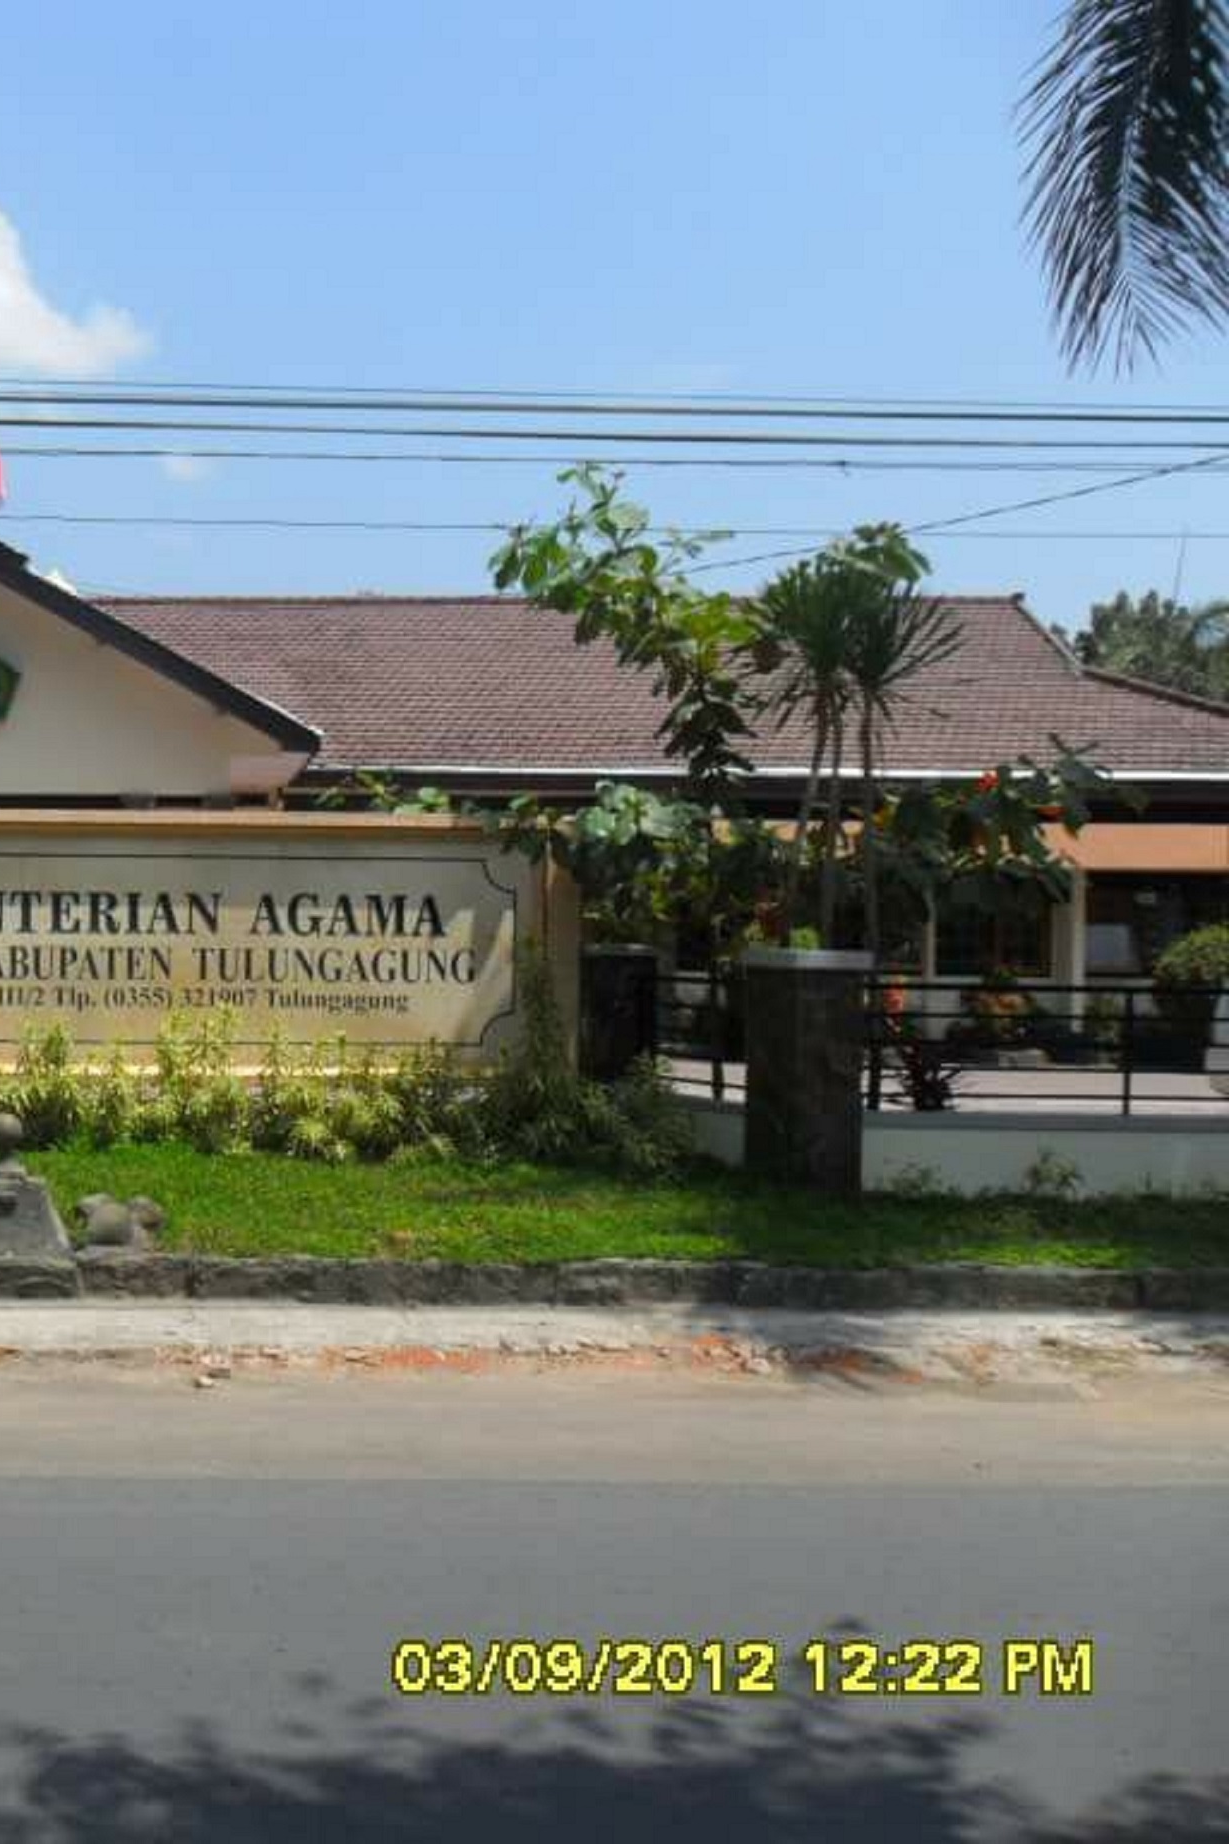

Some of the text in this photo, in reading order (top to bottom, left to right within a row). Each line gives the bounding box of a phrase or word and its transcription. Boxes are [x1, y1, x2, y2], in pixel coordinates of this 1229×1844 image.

[250, 892, 446, 938] AGAMA
[192, 947, 477, 985] TULUNGAGUNG
[55, 986, 97, 1012] Tlp.
[103, 986, 172, 1010] (0355)
[264, 989, 409, 1015] Tulungagung
